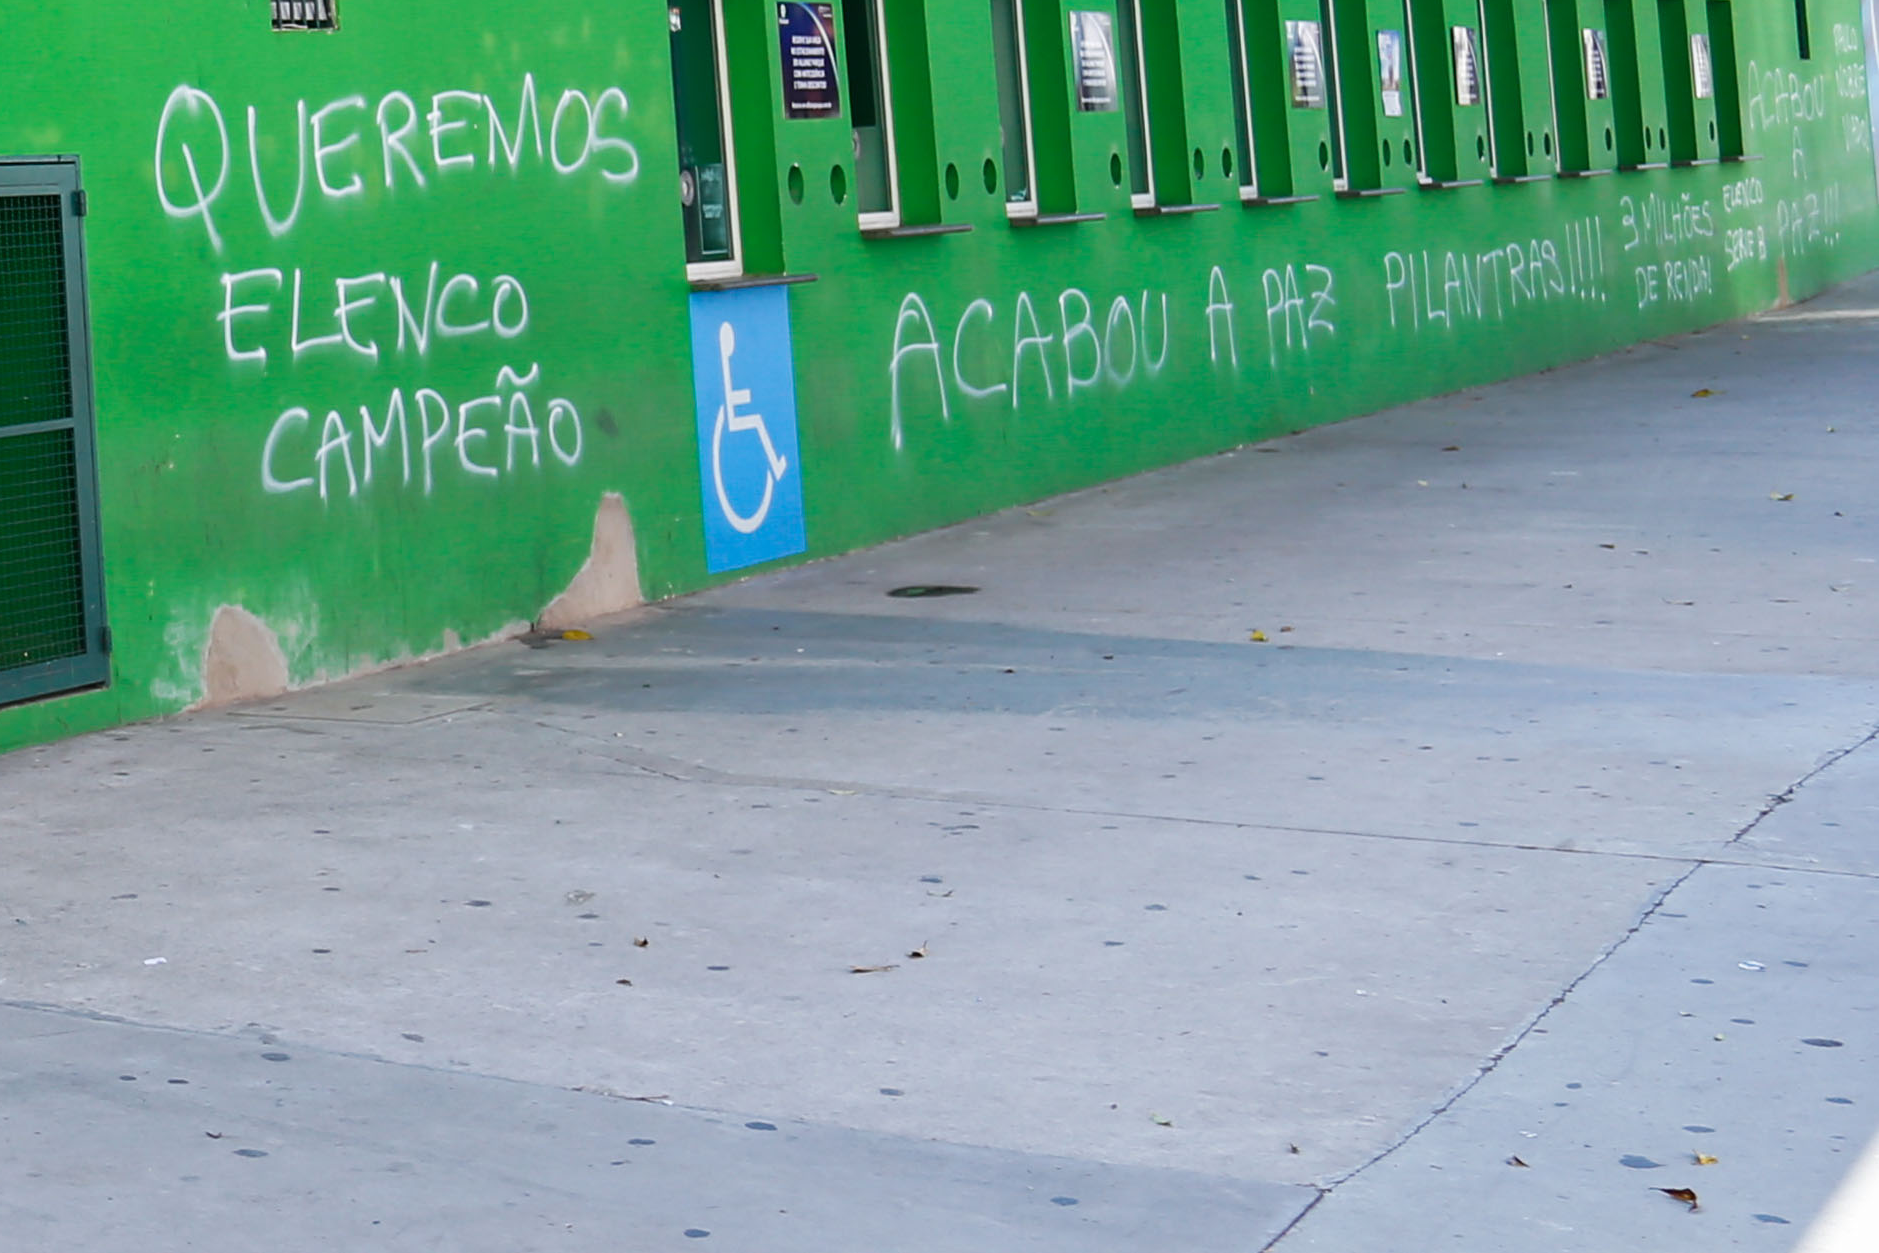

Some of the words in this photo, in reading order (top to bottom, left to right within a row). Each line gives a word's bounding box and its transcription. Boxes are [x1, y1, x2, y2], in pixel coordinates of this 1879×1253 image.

[155, 72, 640, 252] QUEREMOS
[217, 260, 530, 363] ELENCO
[889, 288, 1169, 453] ACABOU
[1205, 265, 1237, 368] A
[1262, 263, 1336, 367] PAZ
[261, 362, 584, 504] CAMPEÃO
